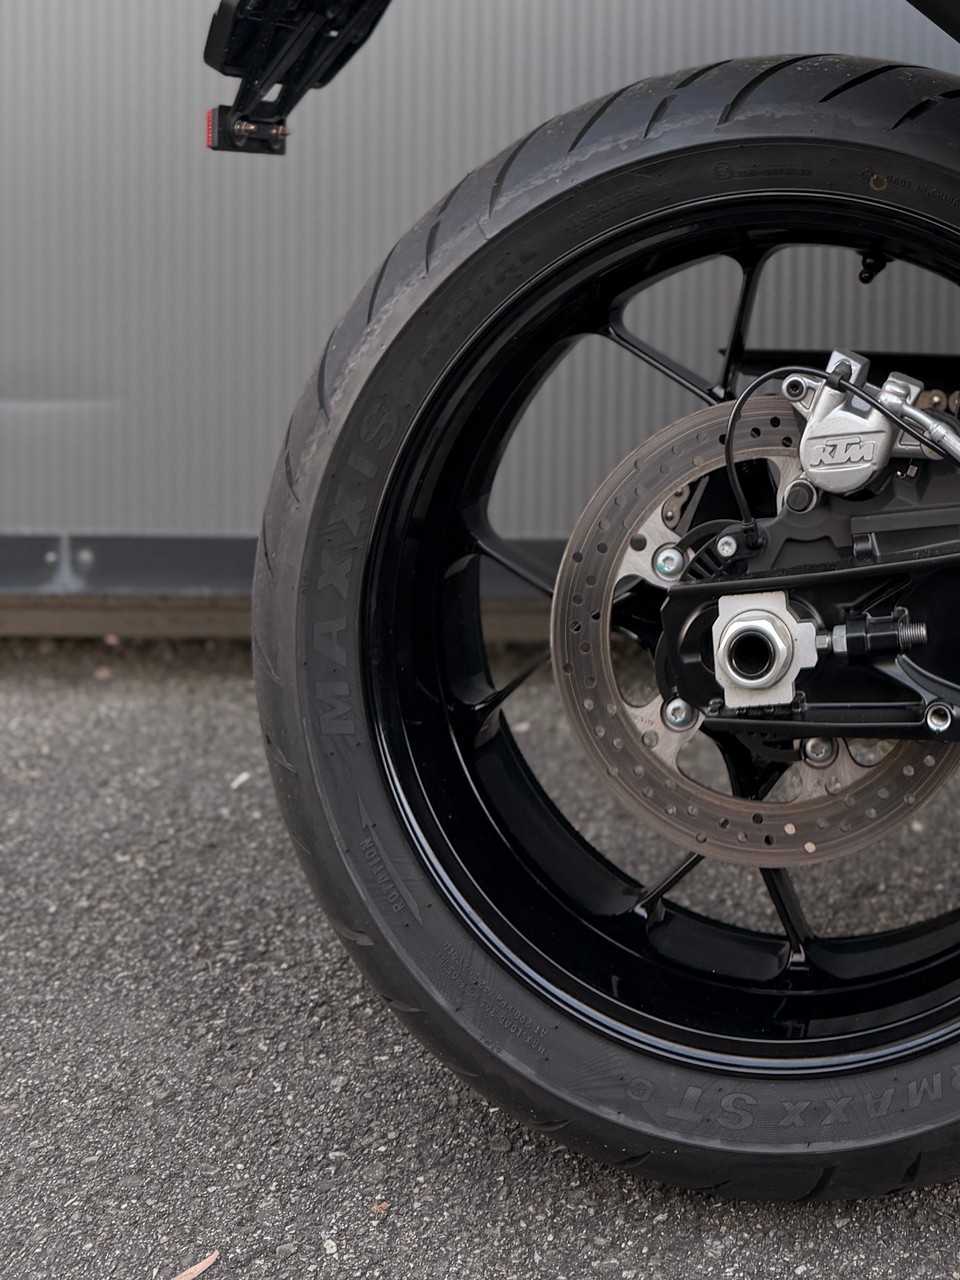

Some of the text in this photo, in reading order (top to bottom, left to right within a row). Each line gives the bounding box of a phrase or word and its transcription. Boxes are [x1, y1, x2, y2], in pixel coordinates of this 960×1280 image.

[810, 437, 875, 467] KTM
[312, 399, 402, 738] MAXXIS
[357, 836, 407, 914] ROTATION
